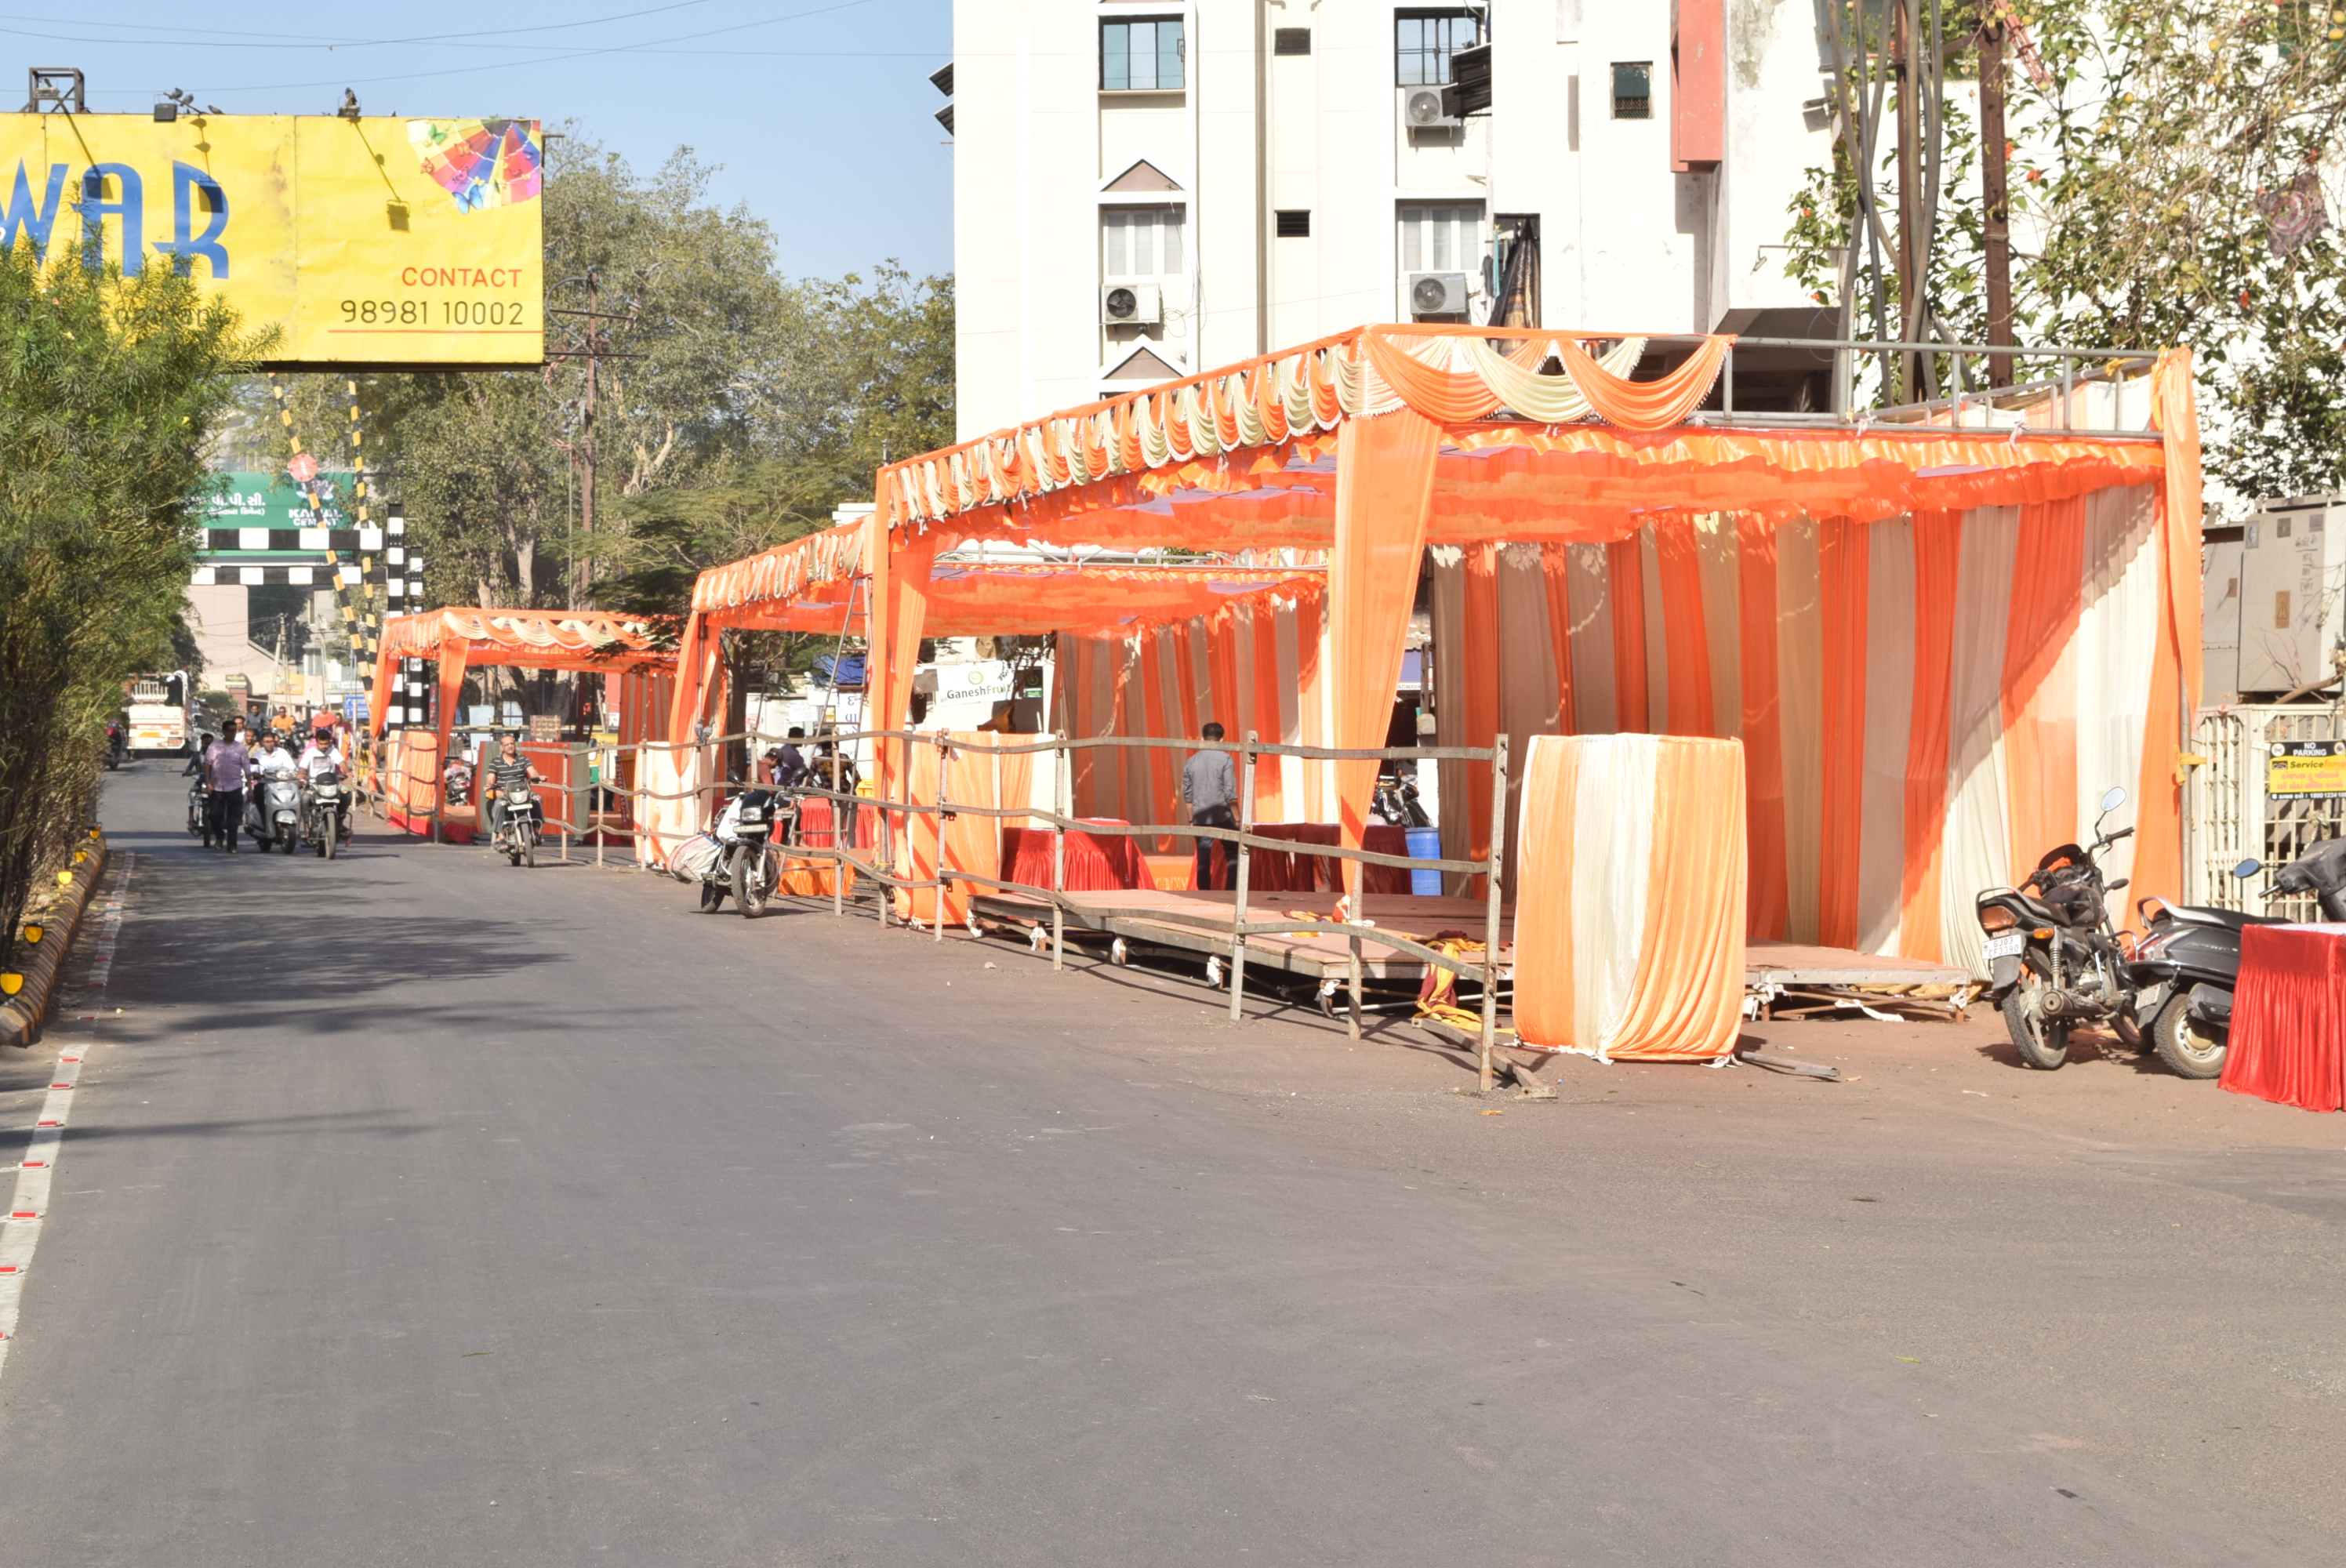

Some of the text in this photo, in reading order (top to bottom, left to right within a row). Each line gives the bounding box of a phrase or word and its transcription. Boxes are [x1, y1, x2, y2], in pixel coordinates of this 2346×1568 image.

[401, 267, 523, 288] CONTACT
[340, 299, 523, 325] 98981 10002
[946, 684, 1011, 699] GaneshFruit
[1994, 937, 2013, 947] GJ03
